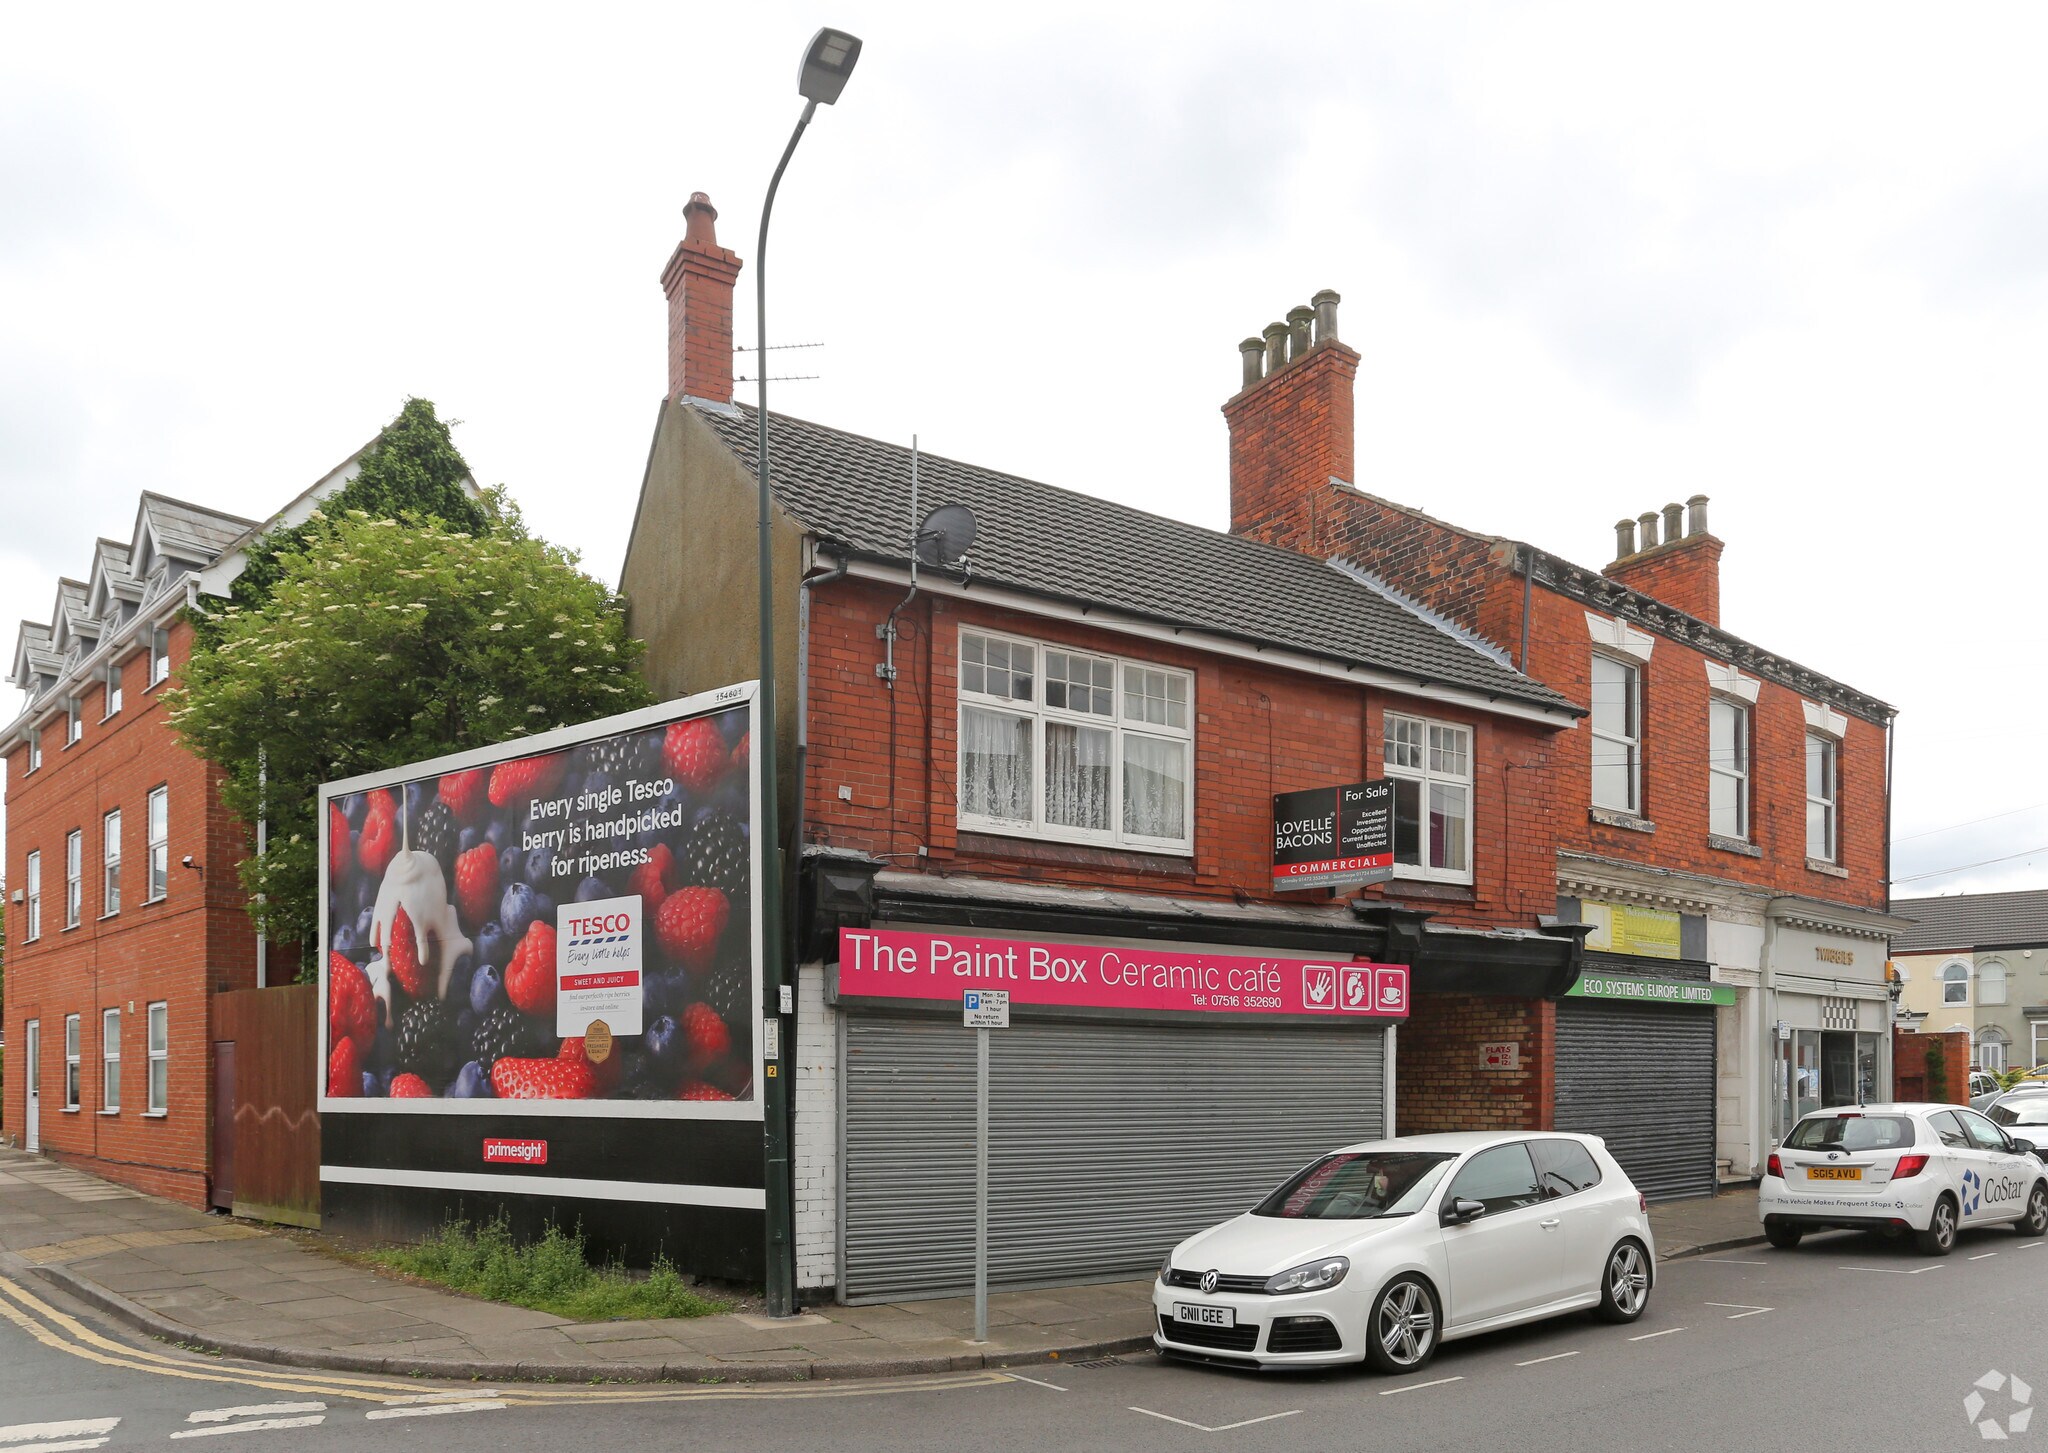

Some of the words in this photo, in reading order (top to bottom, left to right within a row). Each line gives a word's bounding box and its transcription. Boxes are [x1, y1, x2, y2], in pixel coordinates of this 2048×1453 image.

[530, 797, 573, 820] Every
[576, 785, 622, 813] single
[626, 778, 674, 802] Tesco
[1345, 790, 1363, 801] For
[1366, 785, 1388, 798] Sale
[1356, 816, 1387, 826] Investment
[1362, 808, 1387, 818] Excellent
[522, 829, 565, 851] berry
[569, 823, 581, 844] is
[585, 803, 682, 841] handpicked
[1276, 817, 1332, 835] LOVELLE
[1351, 824, 1387, 835] Opportunity/
[1276, 831, 1332, 849] BACONS
[1356, 839, 1387, 849] Unaffected
[1364, 832, 1387, 841] Business
[551, 855, 575, 877] for
[578, 847, 652, 877] ripeness.
[1290, 857, 1377, 874] COMMERCIAL
[568, 913, 631, 936] TESCO
[567, 949, 589, 966] Every
[592, 947, 609, 960] little
[612, 946, 630, 960] helps
[845, 933, 918, 974] The
[930, 939, 1018, 980] Paint
[1029, 947, 1088, 984] Box
[1100, 952, 1220, 990] Ceramic
[1228, 962, 1281, 993] café
[574, 977, 592, 986] SWEET
[593, 976, 605, 984] AND
[607, 975, 624, 984] JUICY
[1584, 979, 1602, 994] ECO
[1605, 980, 1645, 997] SYSTEMS
[1647, 983, 1679, 999] EUROPE
[1681, 987, 1712, 1001] LIMITED
[1191, 993, 1208, 1006] Tel:
[1211, 994, 1240, 1007] 07516
[1243, 995, 1282, 1008] 352690
[769, 1067, 776, 1075] 2
[487, 1141, 542, 1161] primesight
[1813, 1168, 1835, 1178] SG15
[1836, 1168, 1856, 1179] AVU
[1984, 1176, 2024, 1204] CoStar
[1790, 1198, 1812, 1206] Vehicle
[1836, 1200, 1868, 1208] Frequent
[1870, 1201, 1891, 1209] Stops
[1202, 1308, 1223, 1323] GEE
